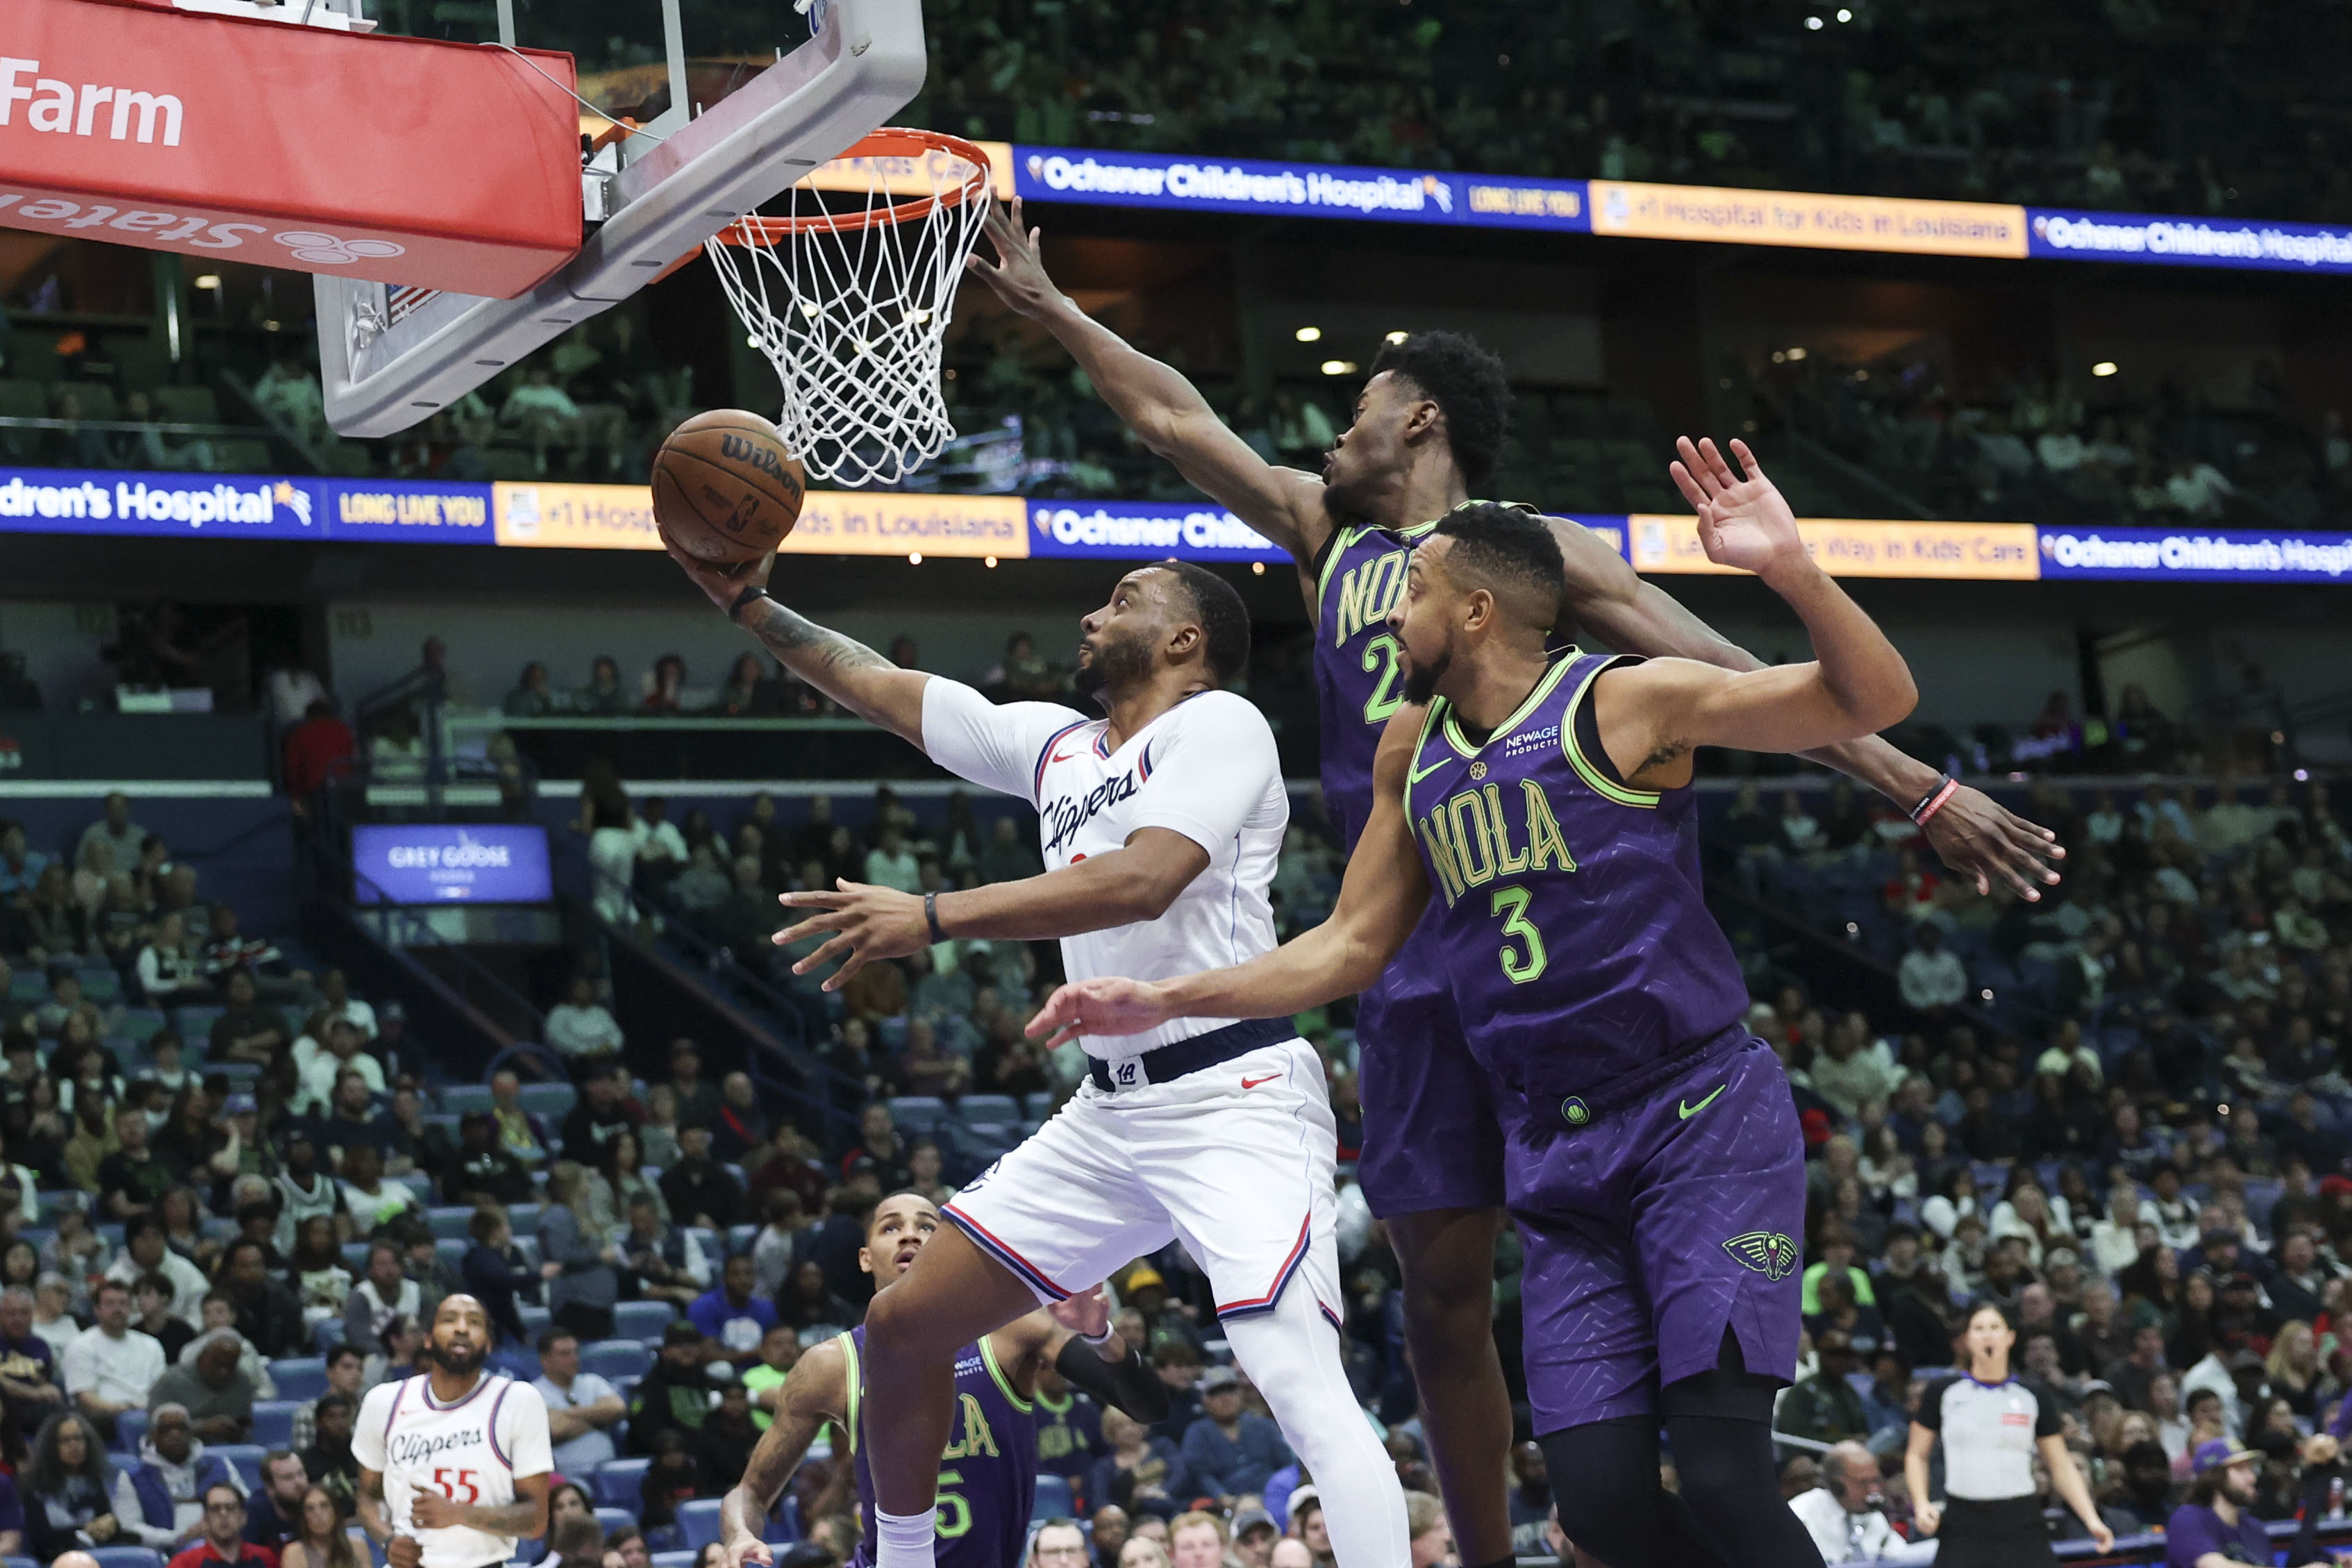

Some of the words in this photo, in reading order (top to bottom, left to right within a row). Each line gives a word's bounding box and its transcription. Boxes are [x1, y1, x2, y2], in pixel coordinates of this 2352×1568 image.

[0, 56, 183, 147] Farm
[1044, 156, 1164, 196] Ochsner
[1166, 163, 1307, 204] Children's
[1306, 172, 1425, 213] Hospital
[18, 199, 268, 249] State
[2046, 216, 2146, 252] Ochsner
[721, 433, 801, 503] Wilson
[116, 481, 274, 528] Hospital
[339, 492, 397, 524] LONG
[397, 494, 442, 526] LIVE
[442, 496, 486, 528] YOU
[842, 508, 868, 535] in
[876, 509, 1016, 539] Louisiana
[1051, 508, 1182, 547] Ochsner
[2054, 534, 2160, 568] Ochsner
[1506, 725, 1558, 749] NEWAGE
[1506, 738, 1558, 758] PRODUCTS
[387, 845, 440, 868] GREY
[441, 844, 510, 868] GOOSE
[1419, 778, 1577, 909] NOLA
[1491, 884, 1547, 983] 3
[1117, 1062, 1136, 1085] LA
[391, 1427, 481, 1465] Clippers
[434, 1467, 479, 1504] 55
